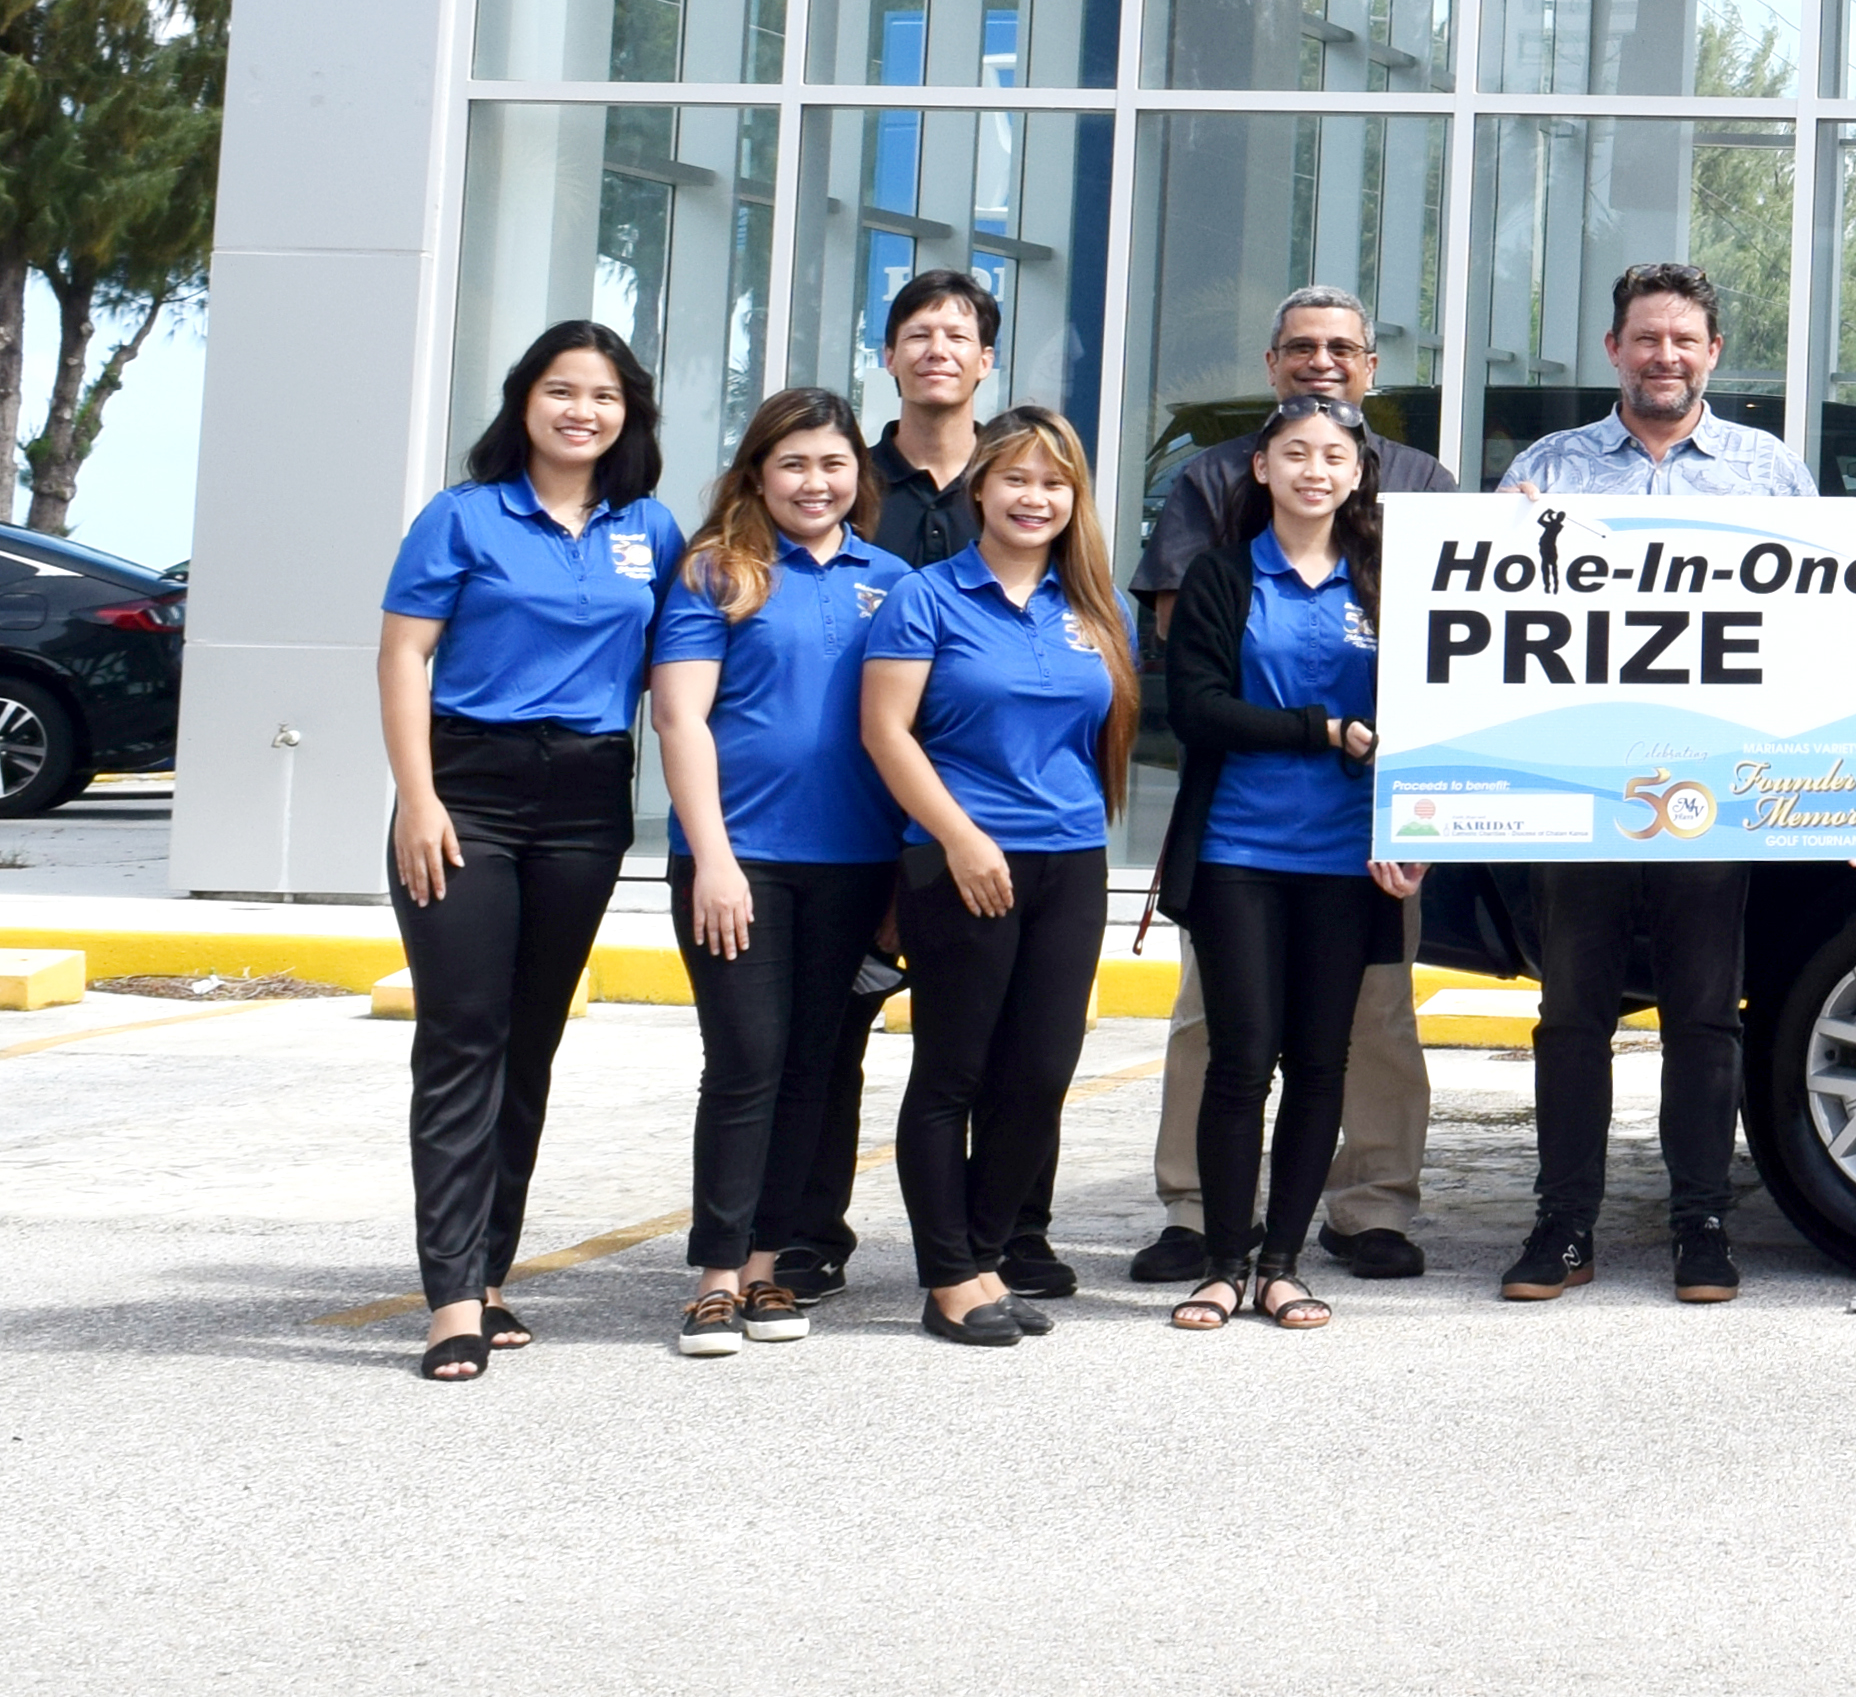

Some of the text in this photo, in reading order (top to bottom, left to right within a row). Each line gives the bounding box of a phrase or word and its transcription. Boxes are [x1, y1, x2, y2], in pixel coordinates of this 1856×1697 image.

[1426, 610, 1763, 685] PRIZE
[1625, 740, 1709, 765] Celebrating
[1743, 743, 1810, 754] MARIANAS
[1393, 780, 1448, 791] Proceeds
[1451, 781, 1463, 791] to
[1613, 766, 1718, 840] 50
[1453, 821, 1525, 830] KARIDAT
[1765, 835, 1799, 847] GOLF
